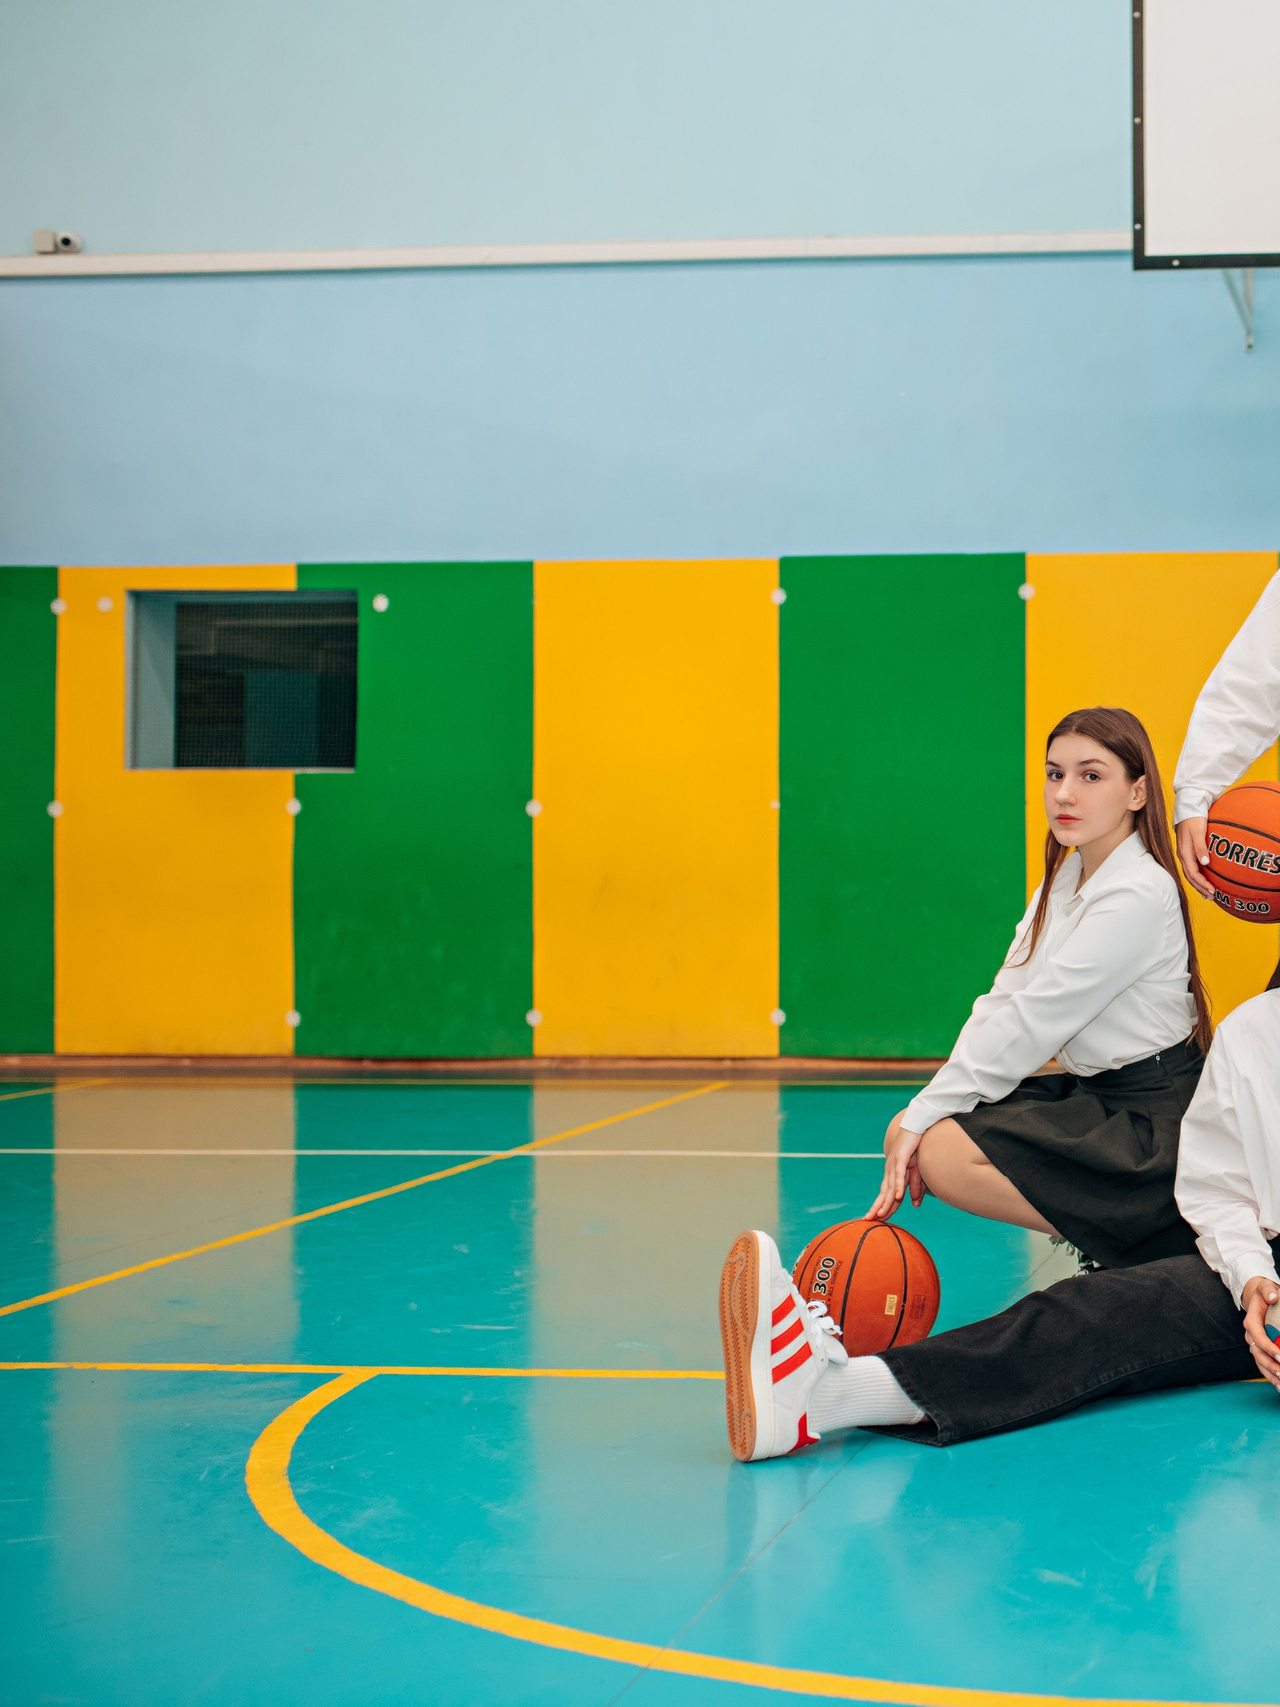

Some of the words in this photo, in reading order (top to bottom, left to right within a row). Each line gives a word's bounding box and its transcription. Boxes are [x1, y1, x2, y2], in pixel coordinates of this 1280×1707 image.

[1214, 889, 1231, 907] M
[1234, 899, 1270, 913] 300
[813, 1256, 836, 1295] 300
